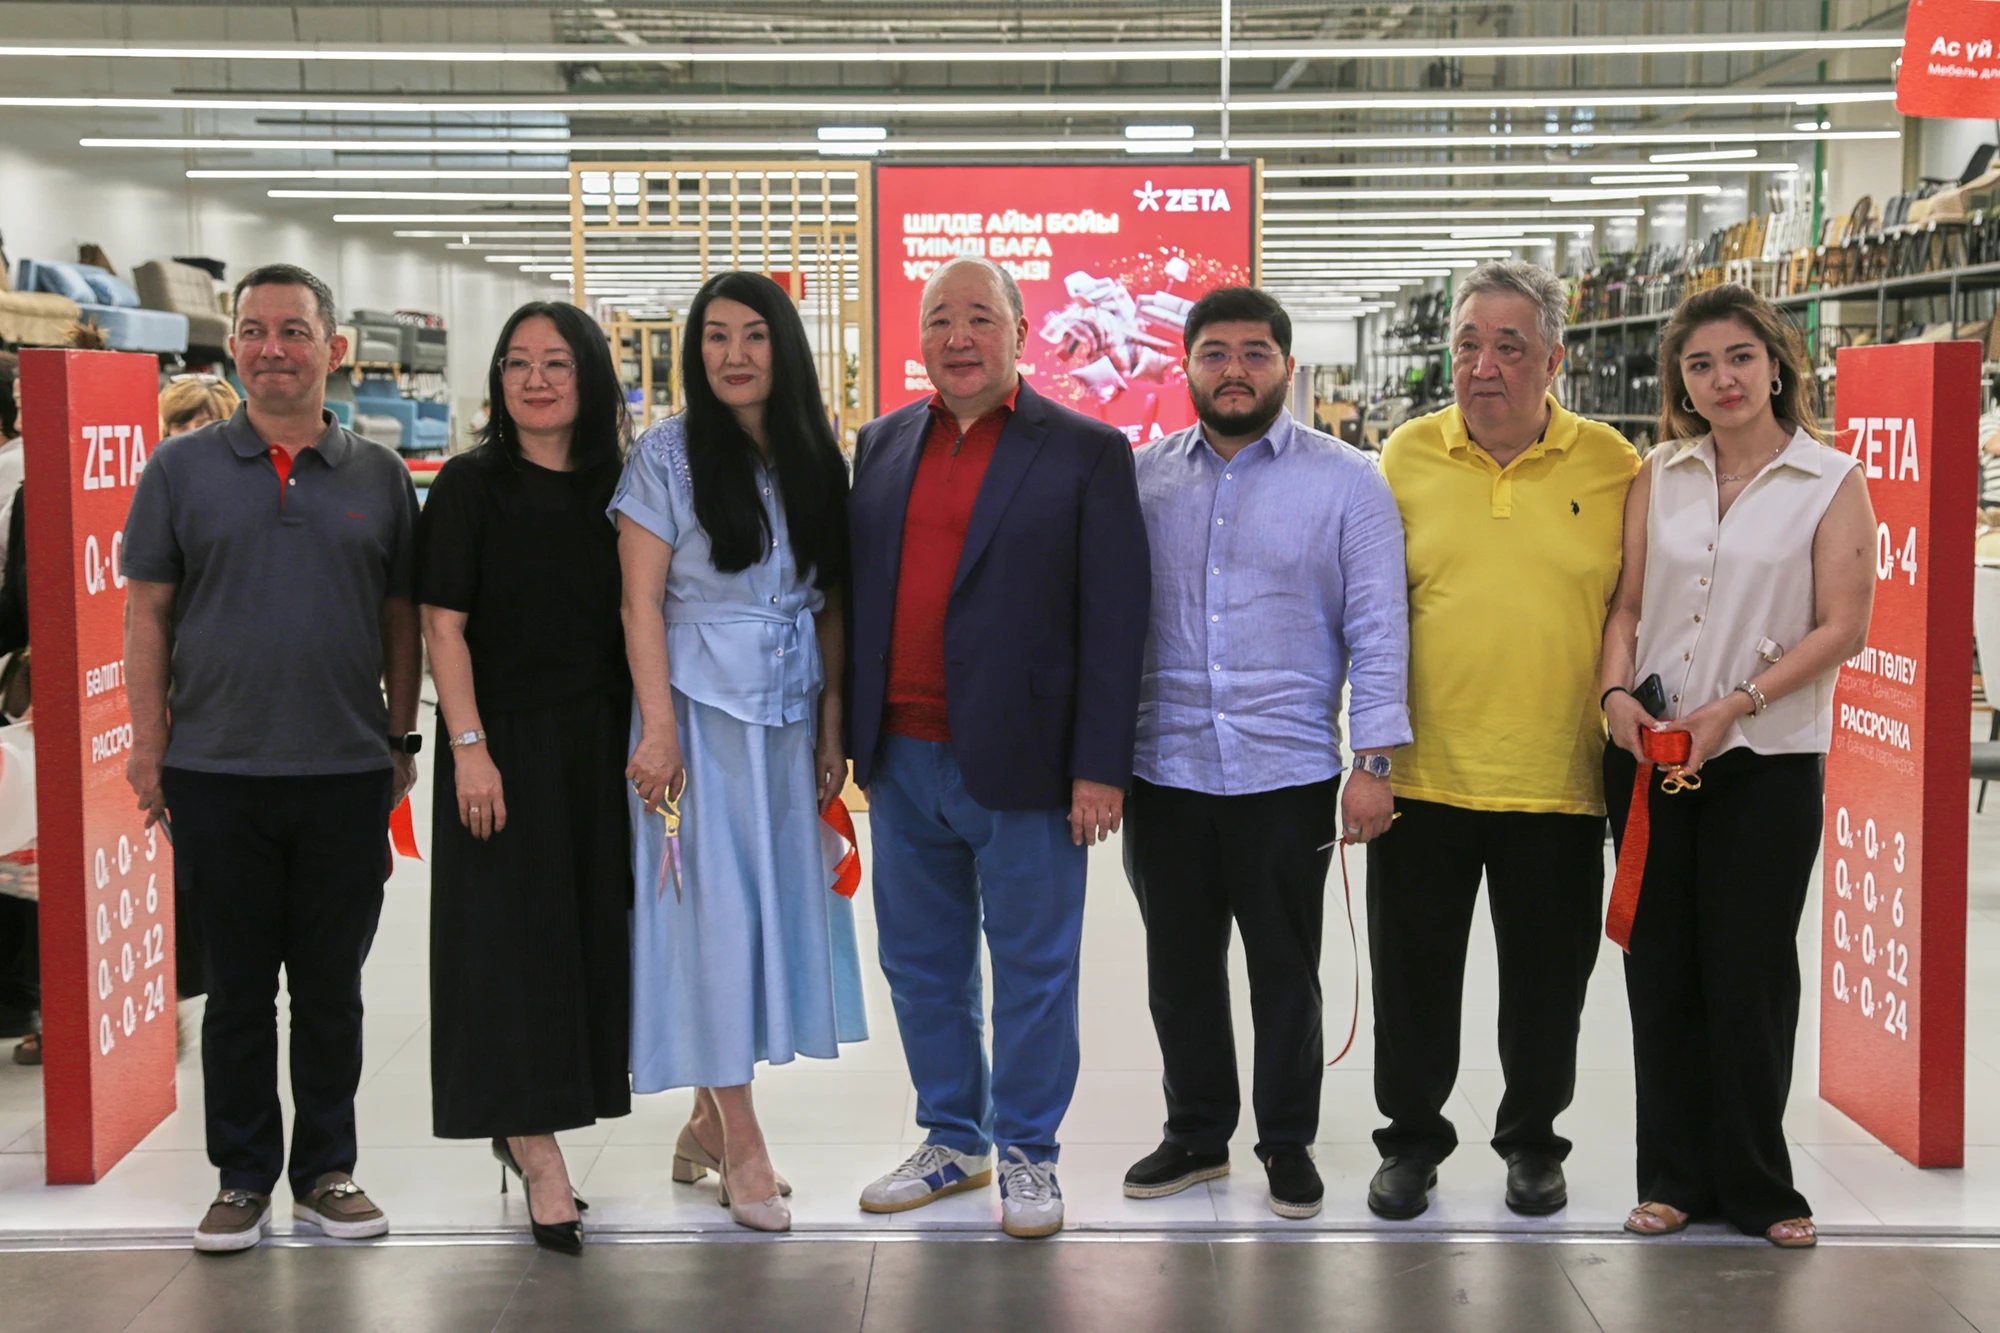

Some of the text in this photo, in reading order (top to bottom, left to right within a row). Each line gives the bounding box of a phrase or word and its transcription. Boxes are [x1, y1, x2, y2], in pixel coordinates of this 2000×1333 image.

[1930, 36, 1961, 56] Ас
[1966, 39, 1993, 62] үй
[1927, 62, 2000, 80] Мебель дл
[1164, 188, 1231, 212] ZETA
[903, 209, 1119, 236] ШІЛДЕ АЙЫ БОЙЫ
[989, 236, 1053, 257] БАҒА
[82, 424, 148, 490] ZETA
[1849, 417, 1920, 482] ZETA
[1878, 649, 1917, 686] ТӨЛЕУ
[92, 722, 134, 764] РАССРО
[1840, 703, 1911, 751] РАССРОЧКА
